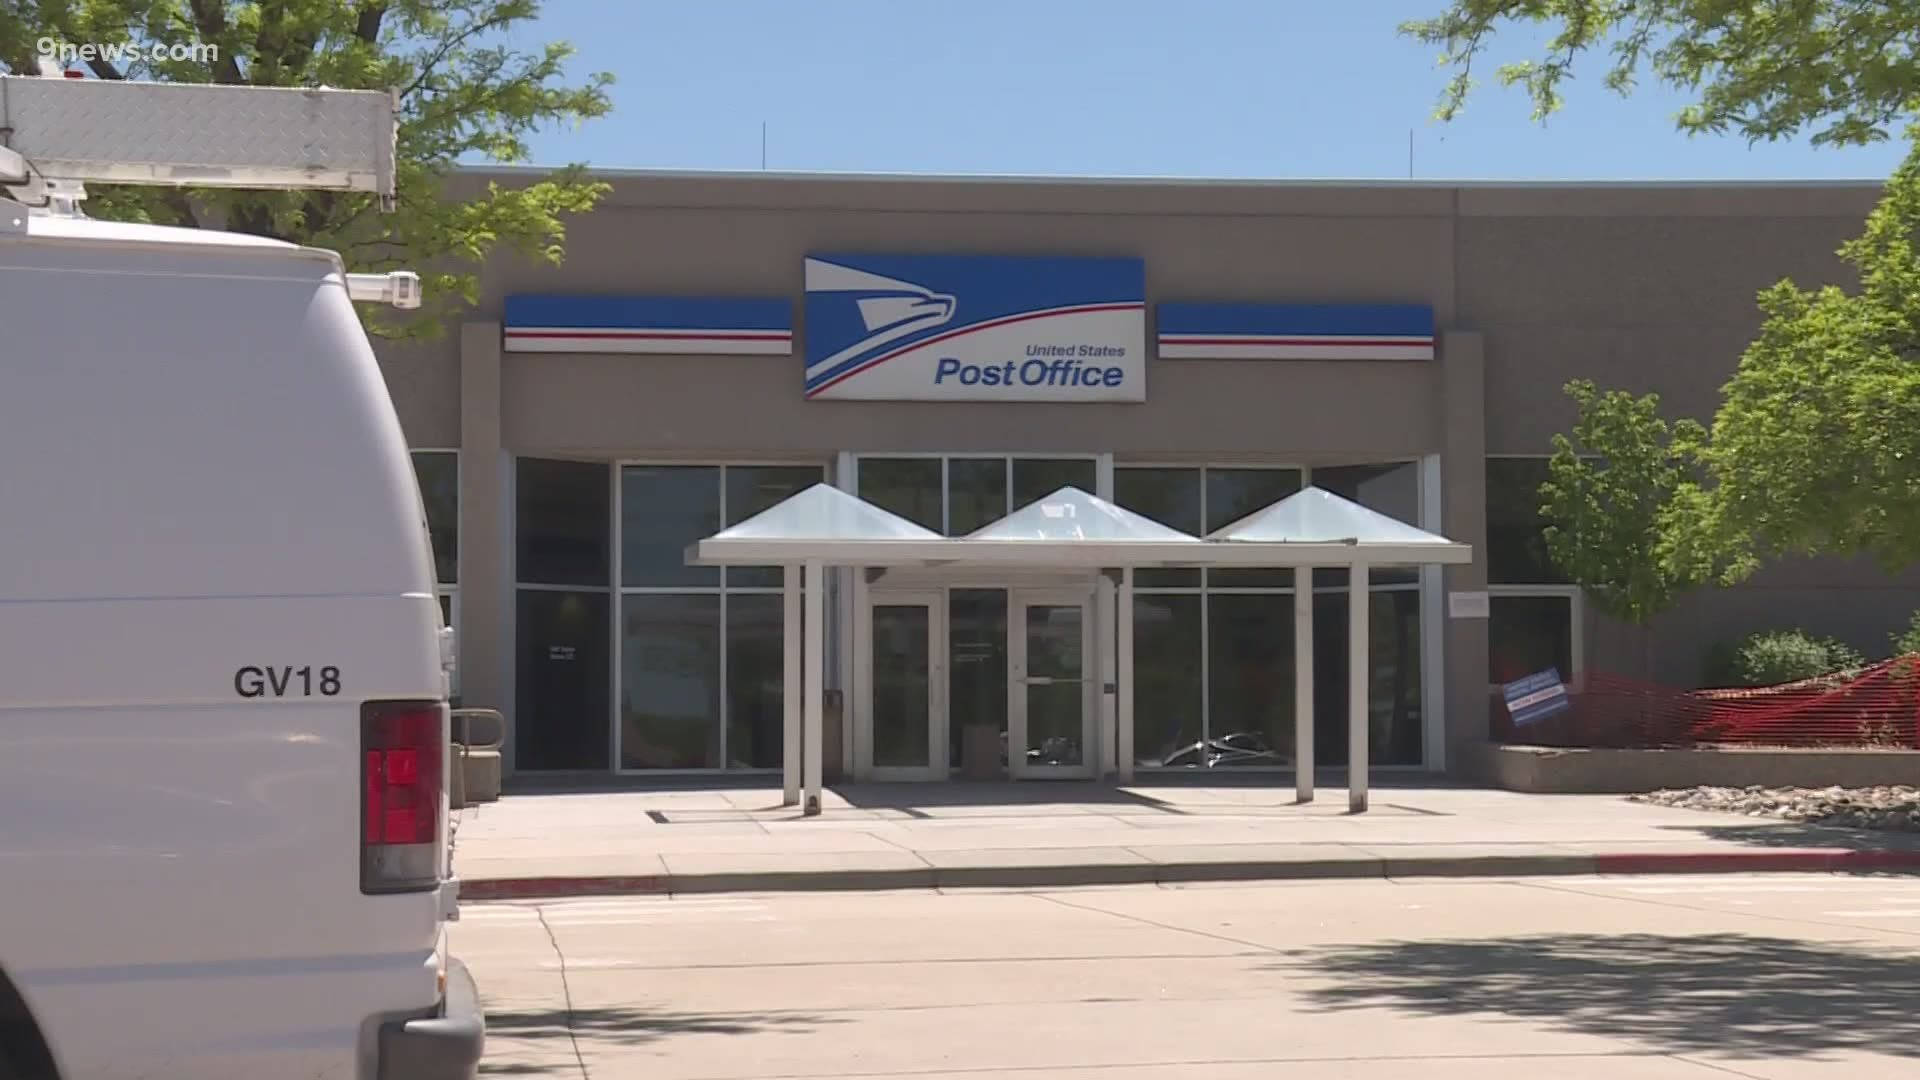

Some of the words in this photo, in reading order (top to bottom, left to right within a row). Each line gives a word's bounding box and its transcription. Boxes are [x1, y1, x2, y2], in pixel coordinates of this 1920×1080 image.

[1025, 344, 1075, 357] United
[1077, 344, 1126, 357] States
[934, 358, 1016, 386] Post
[1019, 359, 1124, 387] Office
[234, 665, 341, 697] GV18
